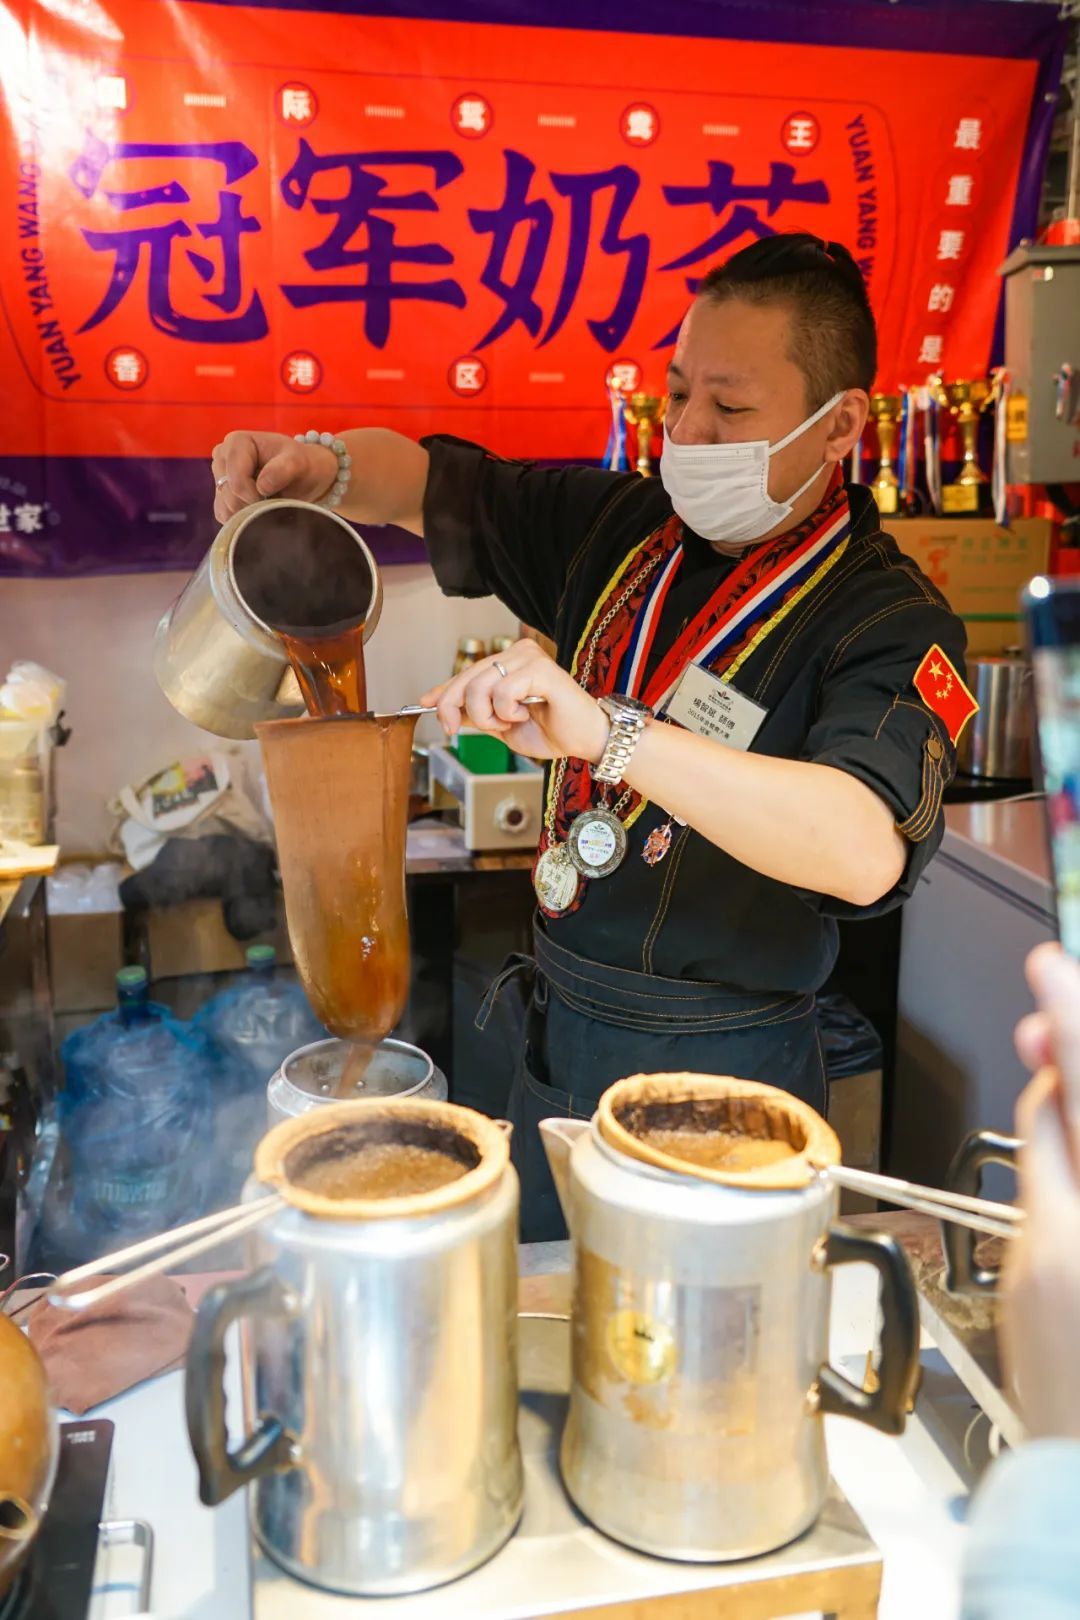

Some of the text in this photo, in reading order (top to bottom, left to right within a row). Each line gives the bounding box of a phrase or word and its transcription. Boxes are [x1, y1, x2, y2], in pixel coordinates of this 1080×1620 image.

[846, 113, 877, 184] YUAN
[19, 162, 42, 239] WANG
[857, 187, 878, 250] YANG
[21, 247, 54, 316] YANG
[37, 320, 82, 390] YUAN
